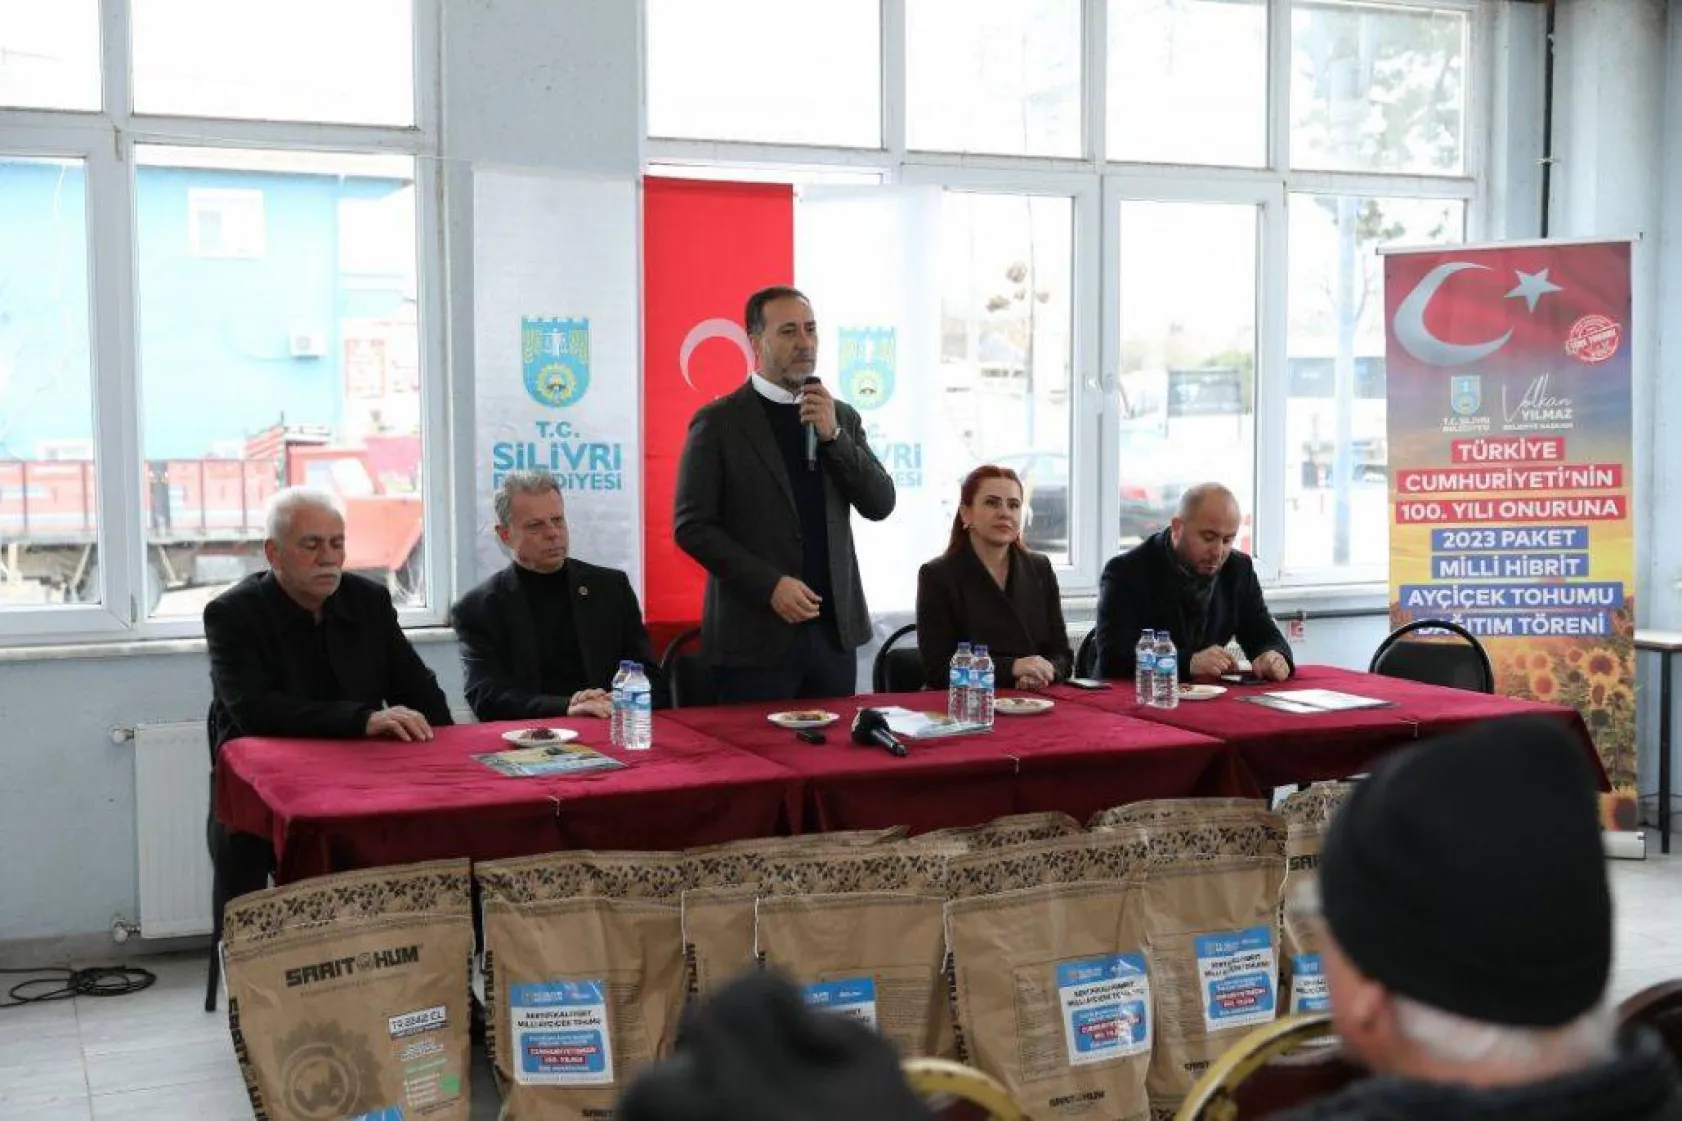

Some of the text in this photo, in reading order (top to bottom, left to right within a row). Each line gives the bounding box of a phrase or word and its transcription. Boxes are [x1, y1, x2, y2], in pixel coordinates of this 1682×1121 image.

[1522, 409, 1572, 421] YILMAZ
[535, 421, 580, 438] T.C.
[493, 442, 622, 470] SİLİVRİ
[1458, 437, 1557, 461] TÜRKİYE
[1405, 466, 1613, 491] CUMHURİYETİ'NİN
[1401, 499, 1619, 521] 100. YILI ONURUNA
[1443, 529, 1577, 548] 2023 PAKET
[1440, 554, 1580, 577] MİLLİ HİBRİT
[1408, 586, 1614, 610] AYÇİÇEK TOHUMU
[1518, 612, 1605, 634] TÖRENİ
